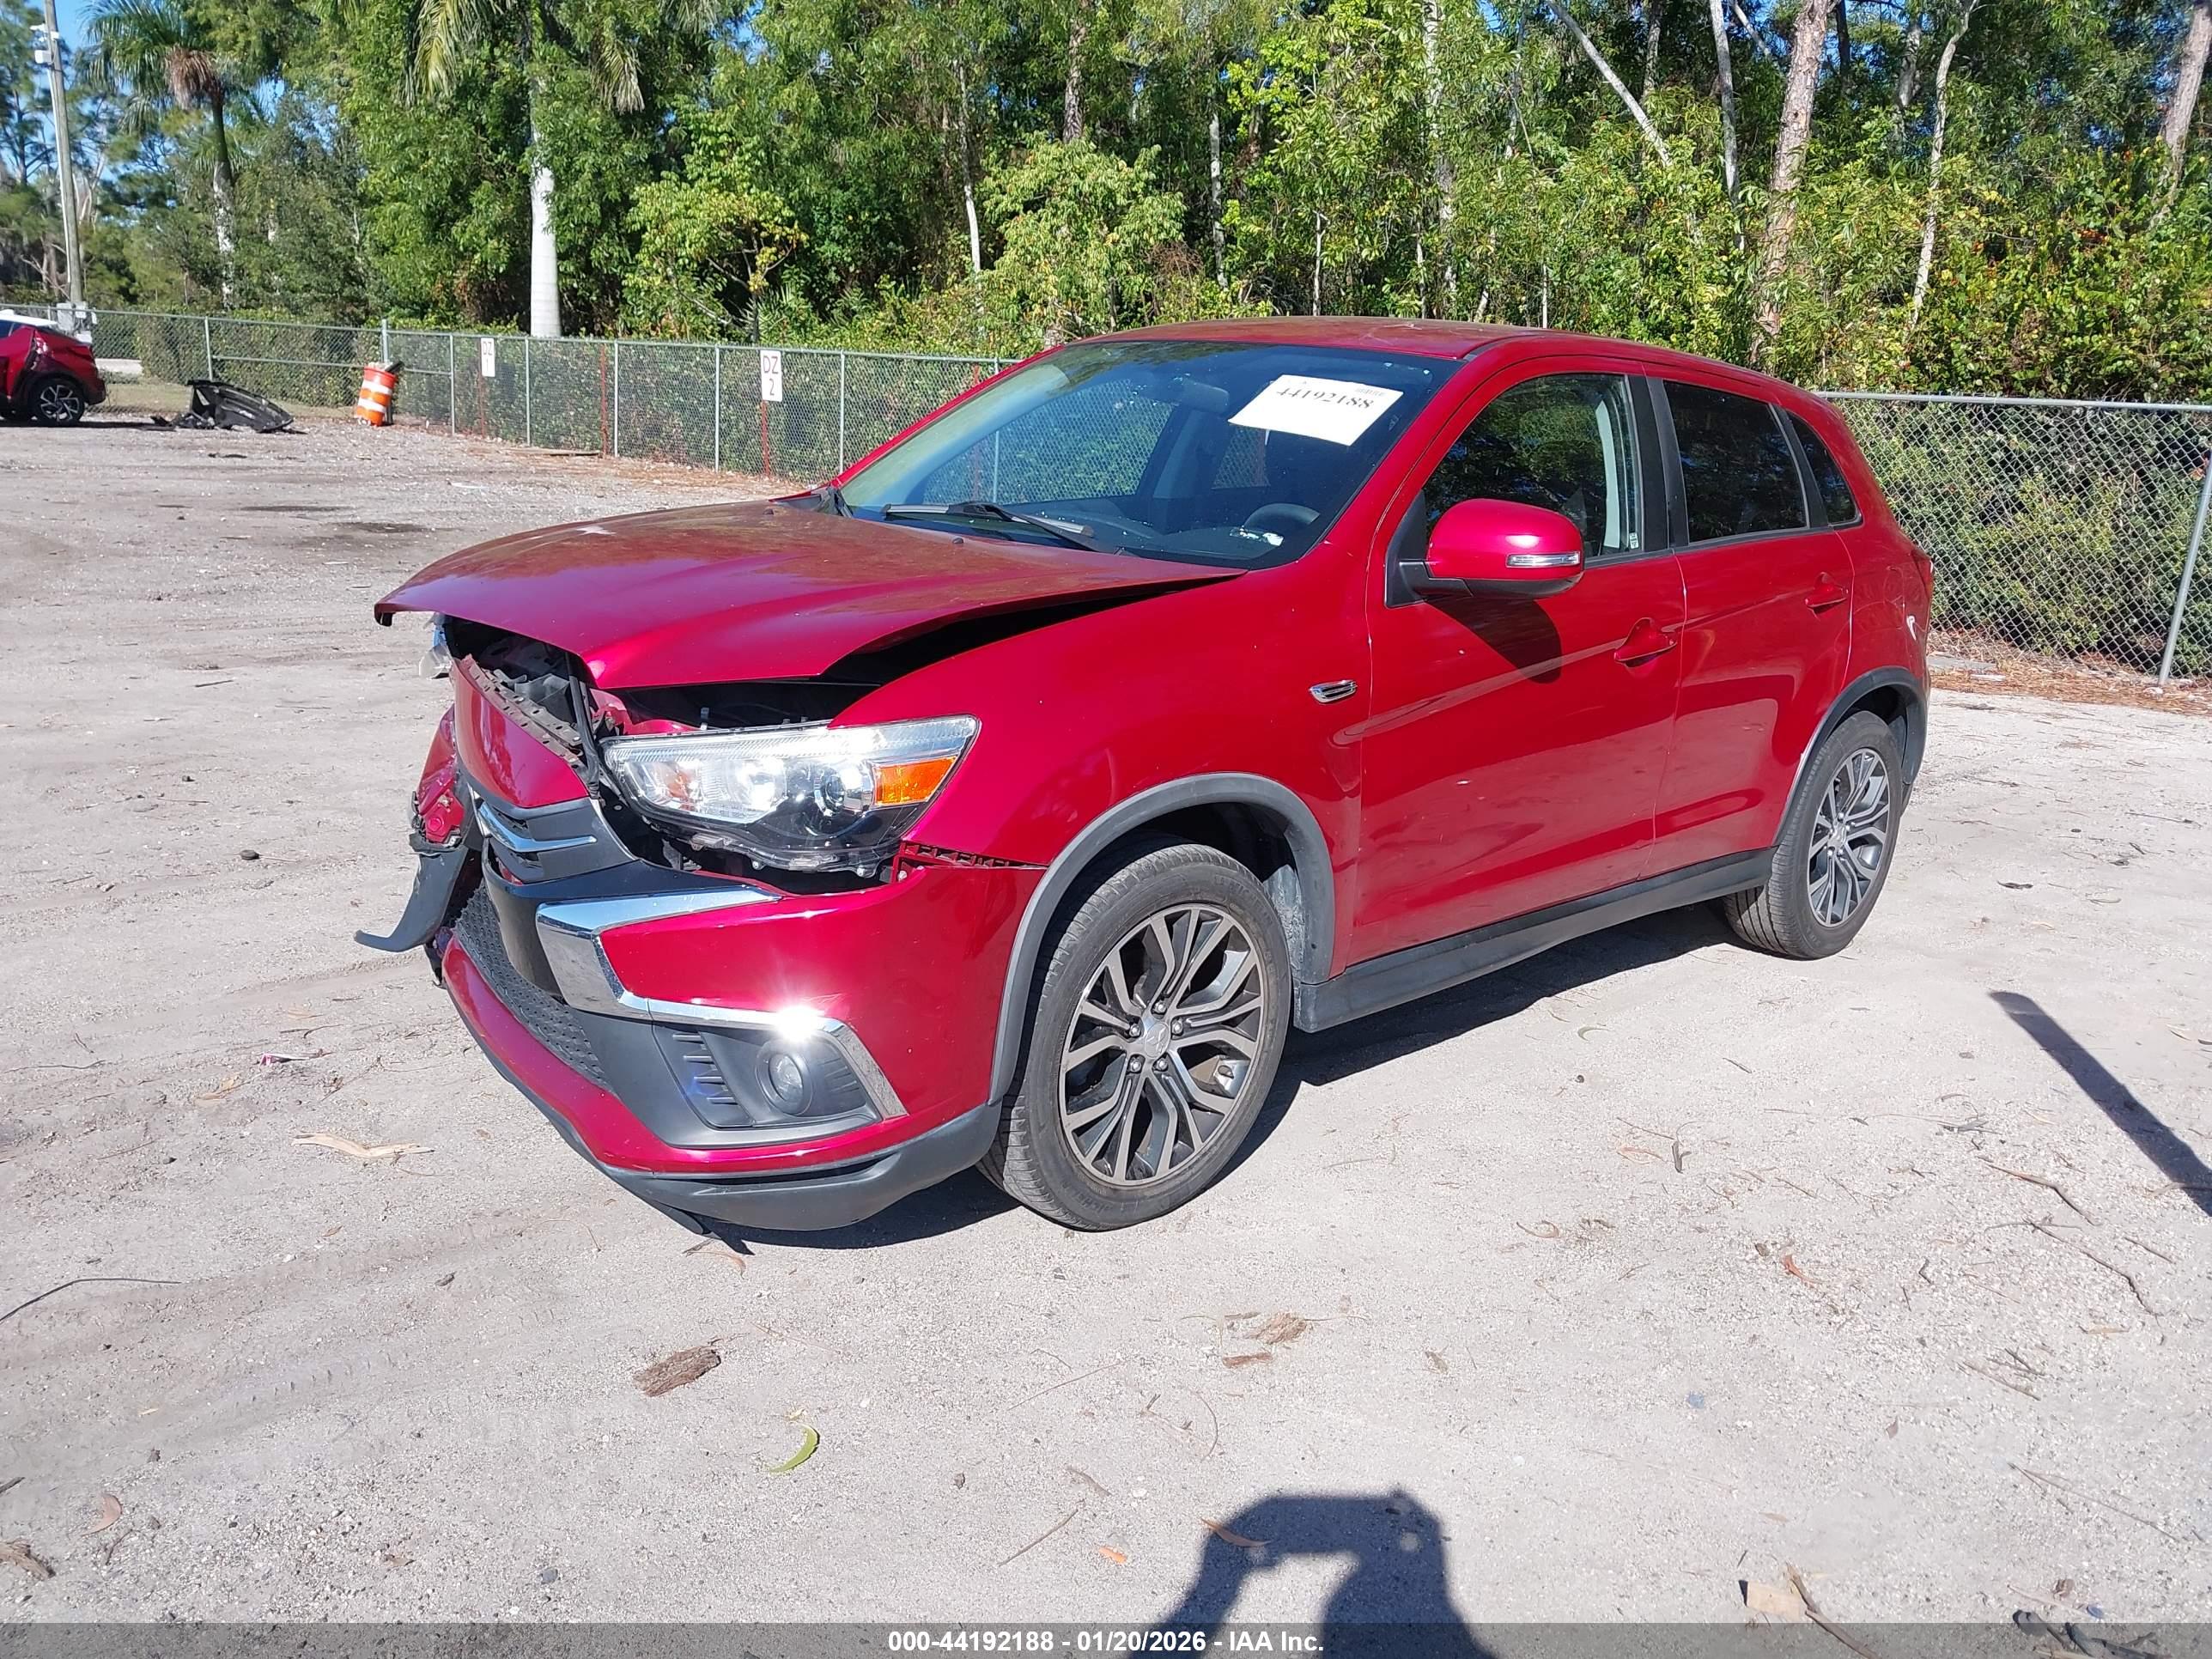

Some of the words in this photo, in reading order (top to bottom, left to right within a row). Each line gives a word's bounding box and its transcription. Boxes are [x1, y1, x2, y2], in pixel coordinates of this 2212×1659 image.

[483, 340, 493, 356] DZ
[763, 355, 779, 374] DZ
[769, 378, 775, 396] 2
[1276, 387, 1374, 409] 44192188
